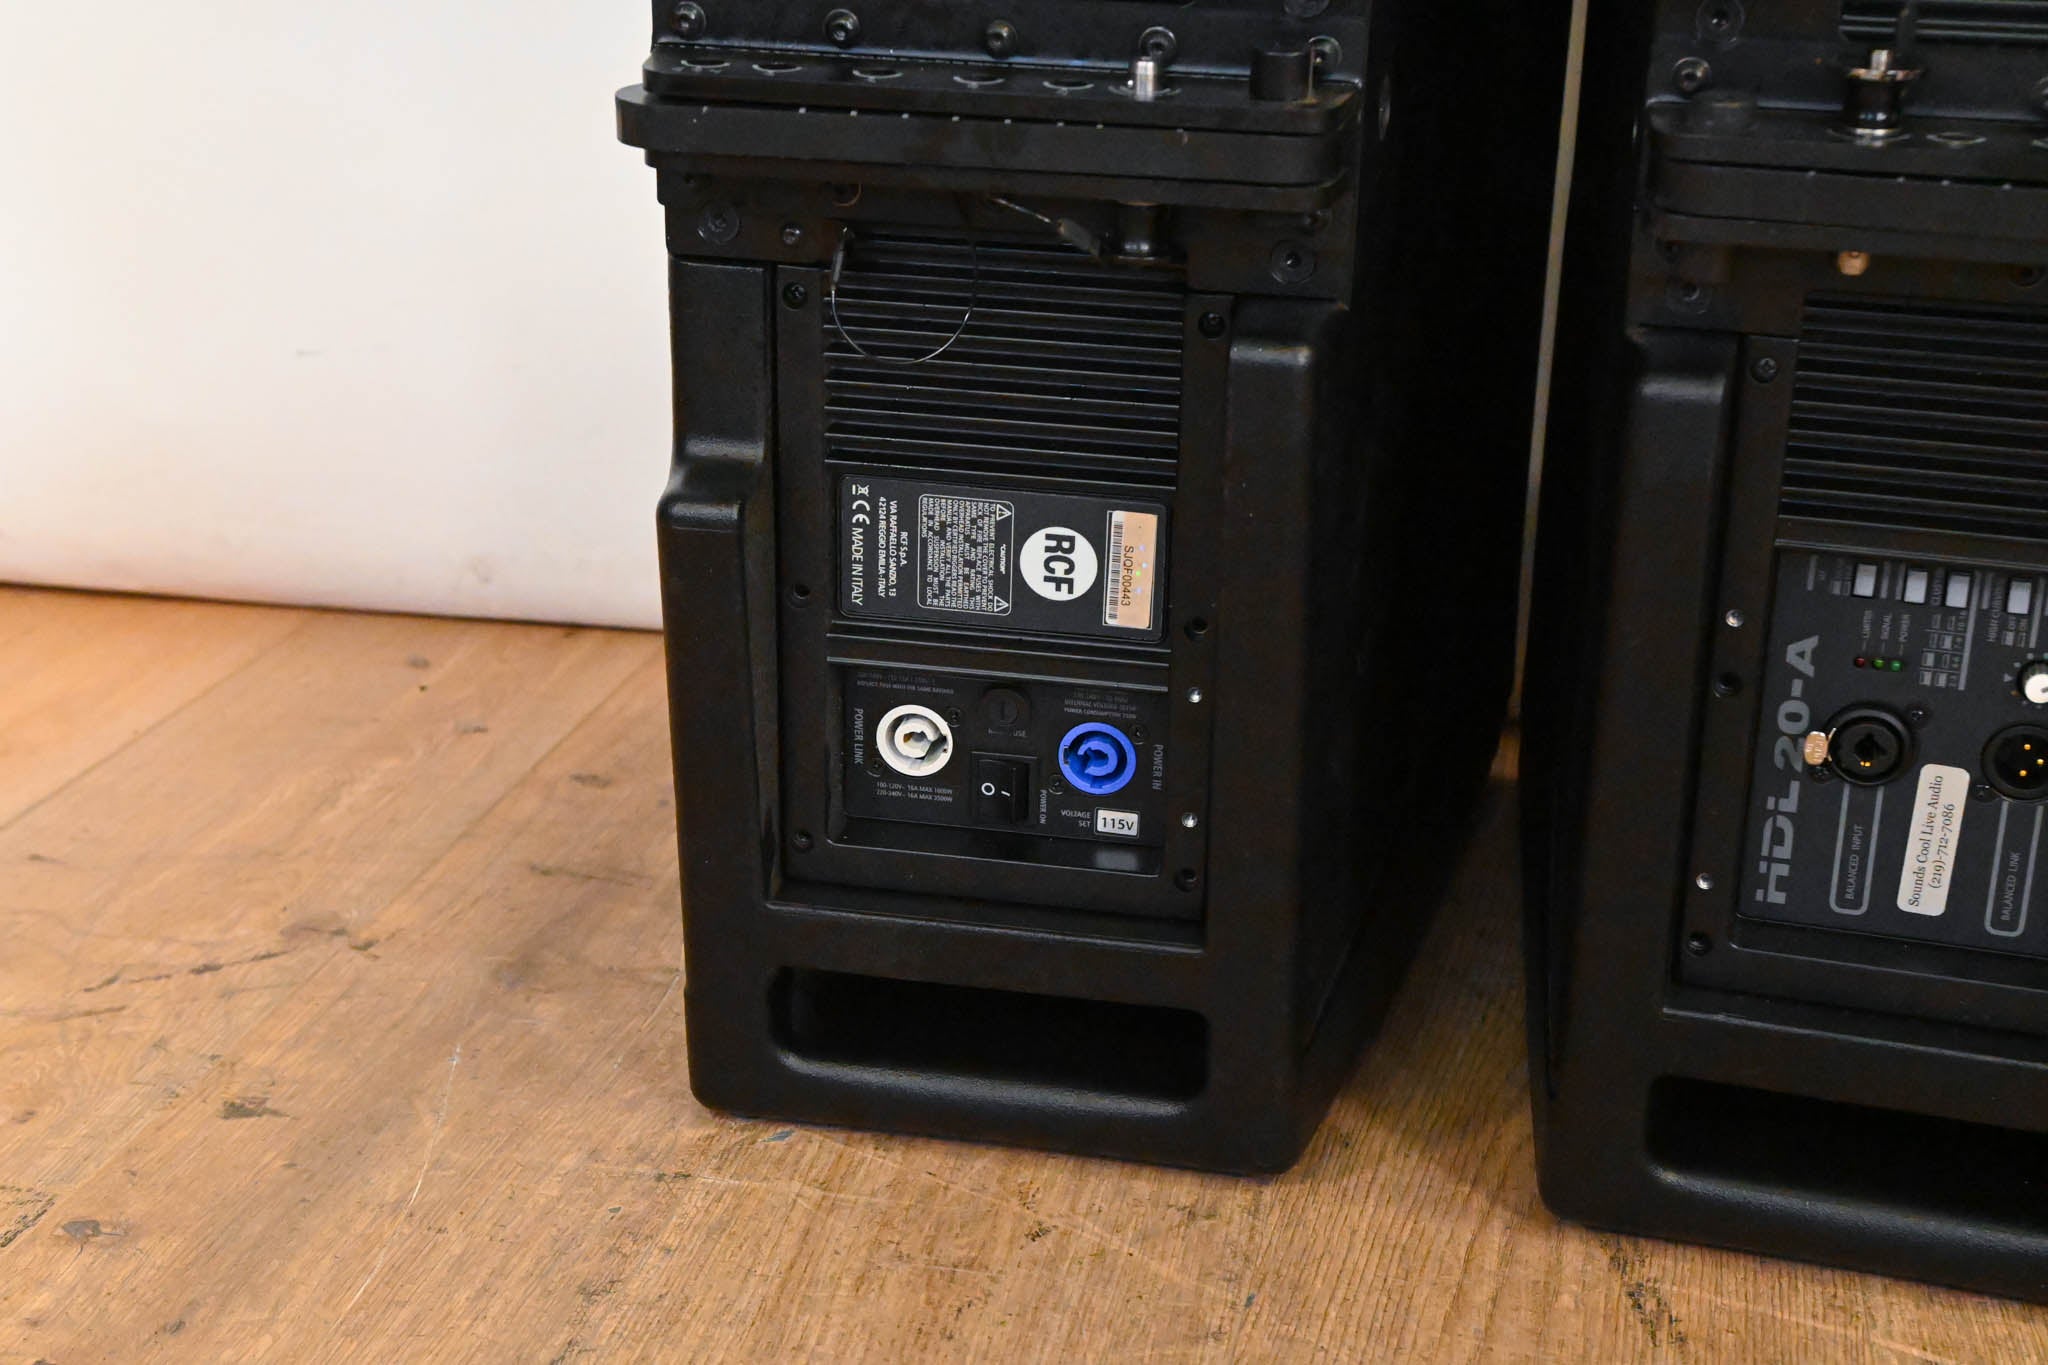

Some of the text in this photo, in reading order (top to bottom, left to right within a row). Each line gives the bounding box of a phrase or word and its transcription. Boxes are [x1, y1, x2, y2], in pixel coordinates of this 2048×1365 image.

[889, 515, 897, 555] RAFFAELLO
[900, 531, 908, 545] RCF
[977, 519, 982, 527] OF
[852, 528, 863, 561] MADE
[852, 564, 862, 575] IN
[888, 557, 896, 586] SANZIO,
[1044, 533, 1075, 594] RCF
[1121, 546, 1134, 606] SJQF00443
[852, 578, 862, 606] ITALY
[889, 588, 896, 596] 13
[982, 576, 987, 584] TO
[988, 602, 993, 611] DO
[854, 708, 864, 765] POWER LINK
[1152, 744, 1164, 791] POWER IN
[1060, 809, 1091, 819] VOLTAGE
[1078, 820, 1091, 828] SET
[1102, 817, 1134, 831] 115V
[1755, 780, 1801, 904] HDL
[1908, 775, 1943, 906] Sounds Cool Live Audio
[1928, 803, 1955, 889] (219)-712-7086
[1844, 824, 1865, 900] BALANCED INPUT
[2000, 851, 2021, 921] BALANCED LINK
